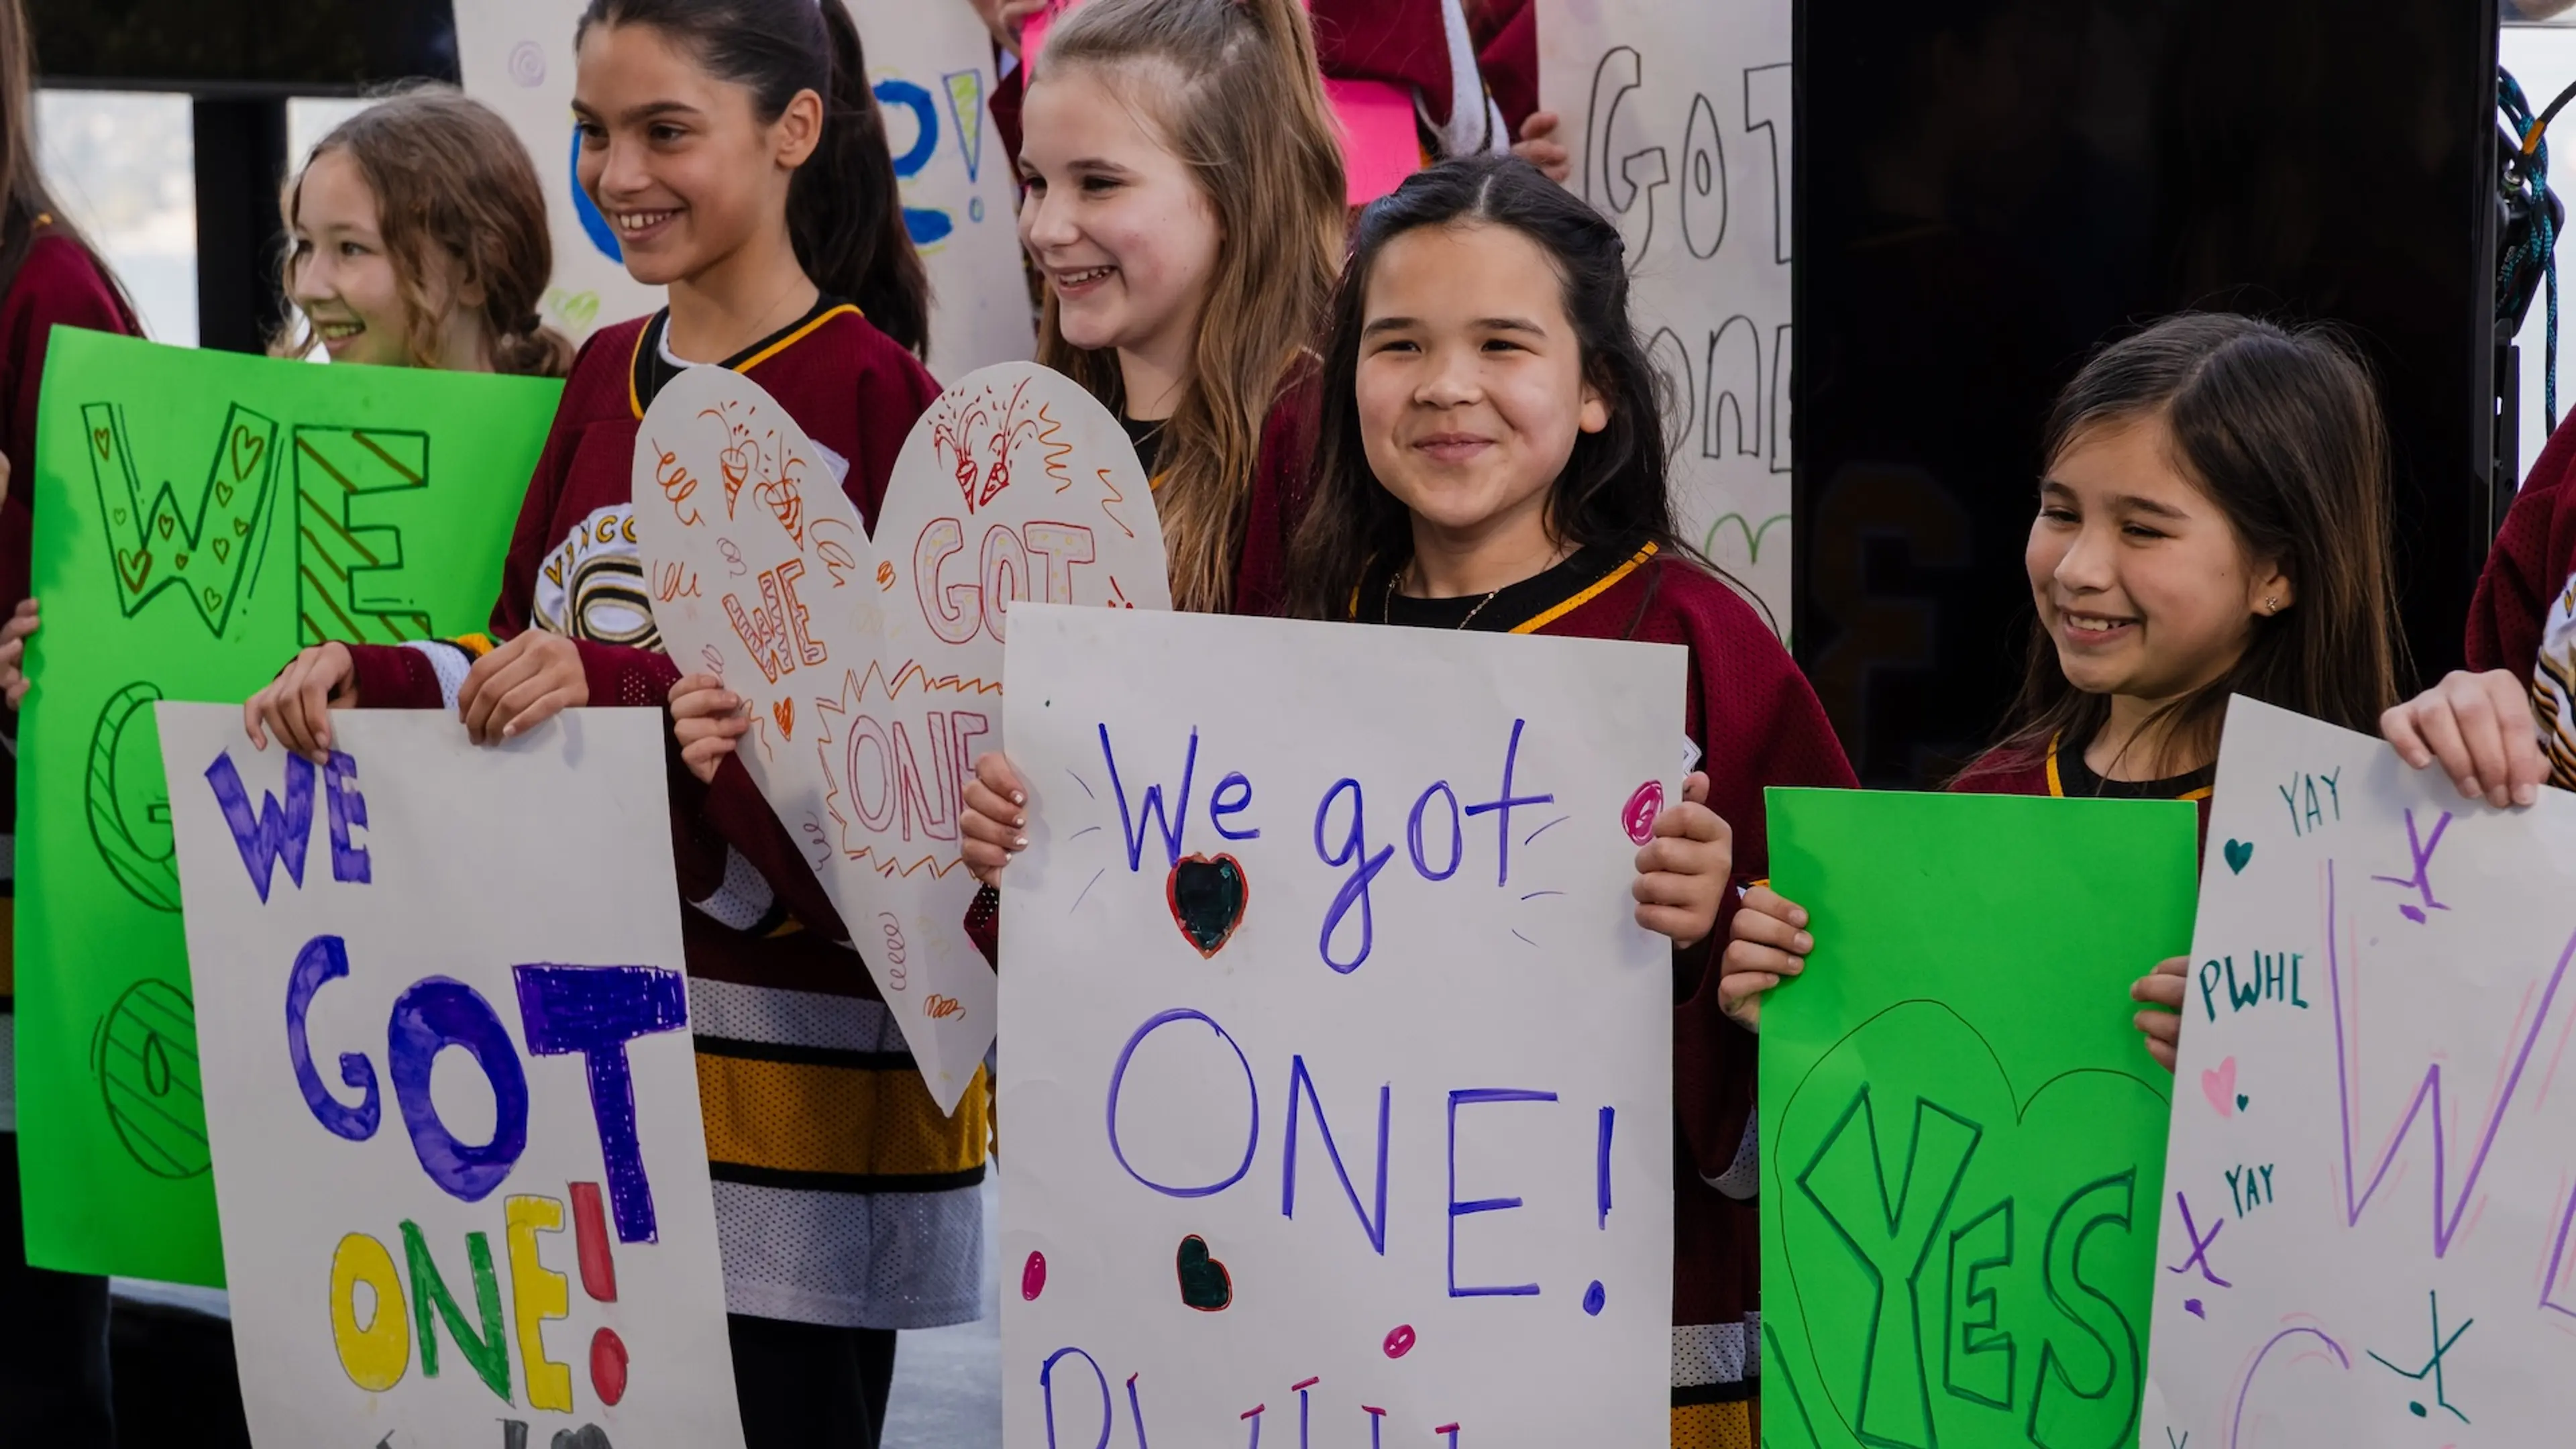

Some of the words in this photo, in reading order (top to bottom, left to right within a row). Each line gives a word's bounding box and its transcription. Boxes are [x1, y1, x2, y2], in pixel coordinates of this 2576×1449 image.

[81, 401, 432, 647] WE
[722, 558, 827, 684] WE
[914, 517, 1095, 645] GOT
[204, 745, 372, 906] WE
[1097, 720, 1260, 872] We
[1313, 717, 1554, 974] got
[2279, 765, 2341, 838] YAY
[285, 934, 689, 1245] GOT
[1106, 1007, 1615, 1317] ONE!
[2224, 1163, 2274, 1219] YAY
[329, 1179, 629, 1414] ONE!
[1794, 1080, 2141, 1449] YES
